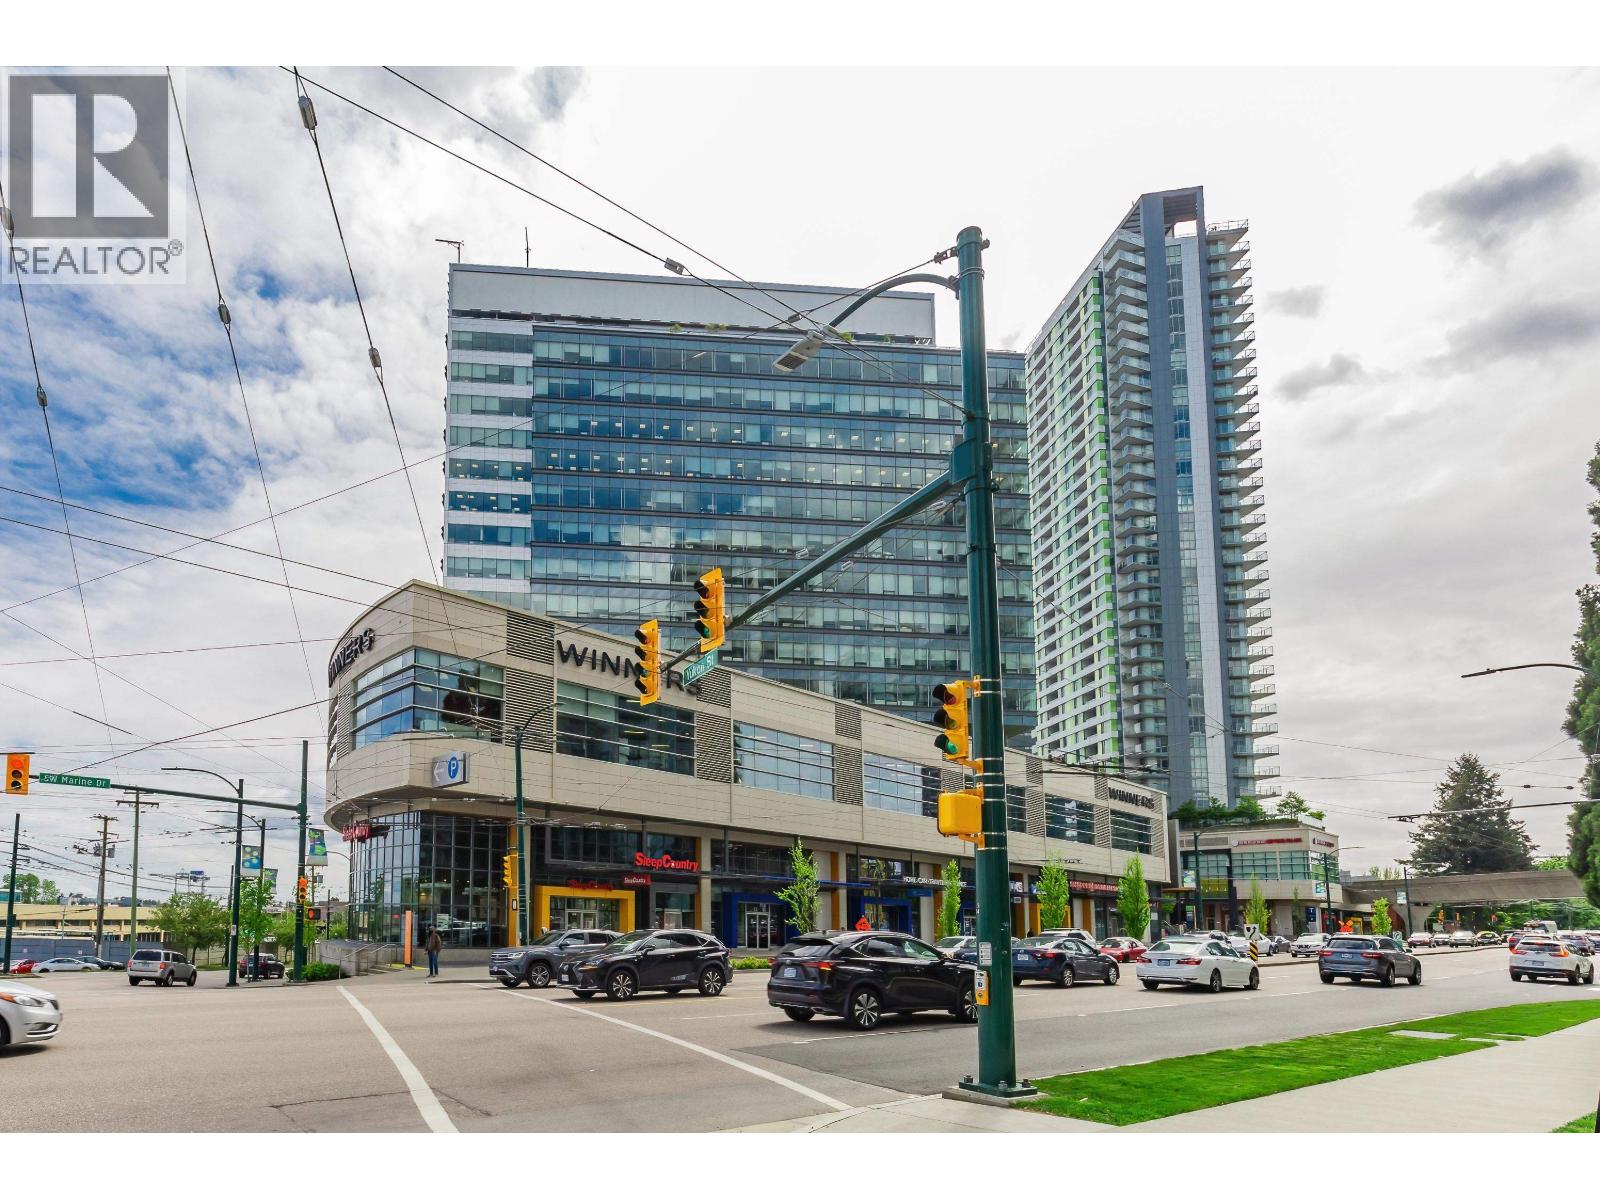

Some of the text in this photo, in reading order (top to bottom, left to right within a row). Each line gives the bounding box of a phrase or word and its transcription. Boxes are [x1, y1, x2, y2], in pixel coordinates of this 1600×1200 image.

[686, 653, 715, 681] Yukon St
[450, 761, 457, 777] P
[44, 774, 107, 787] SW Marine Dr
[1108, 786, 1155, 810] WINNERS
